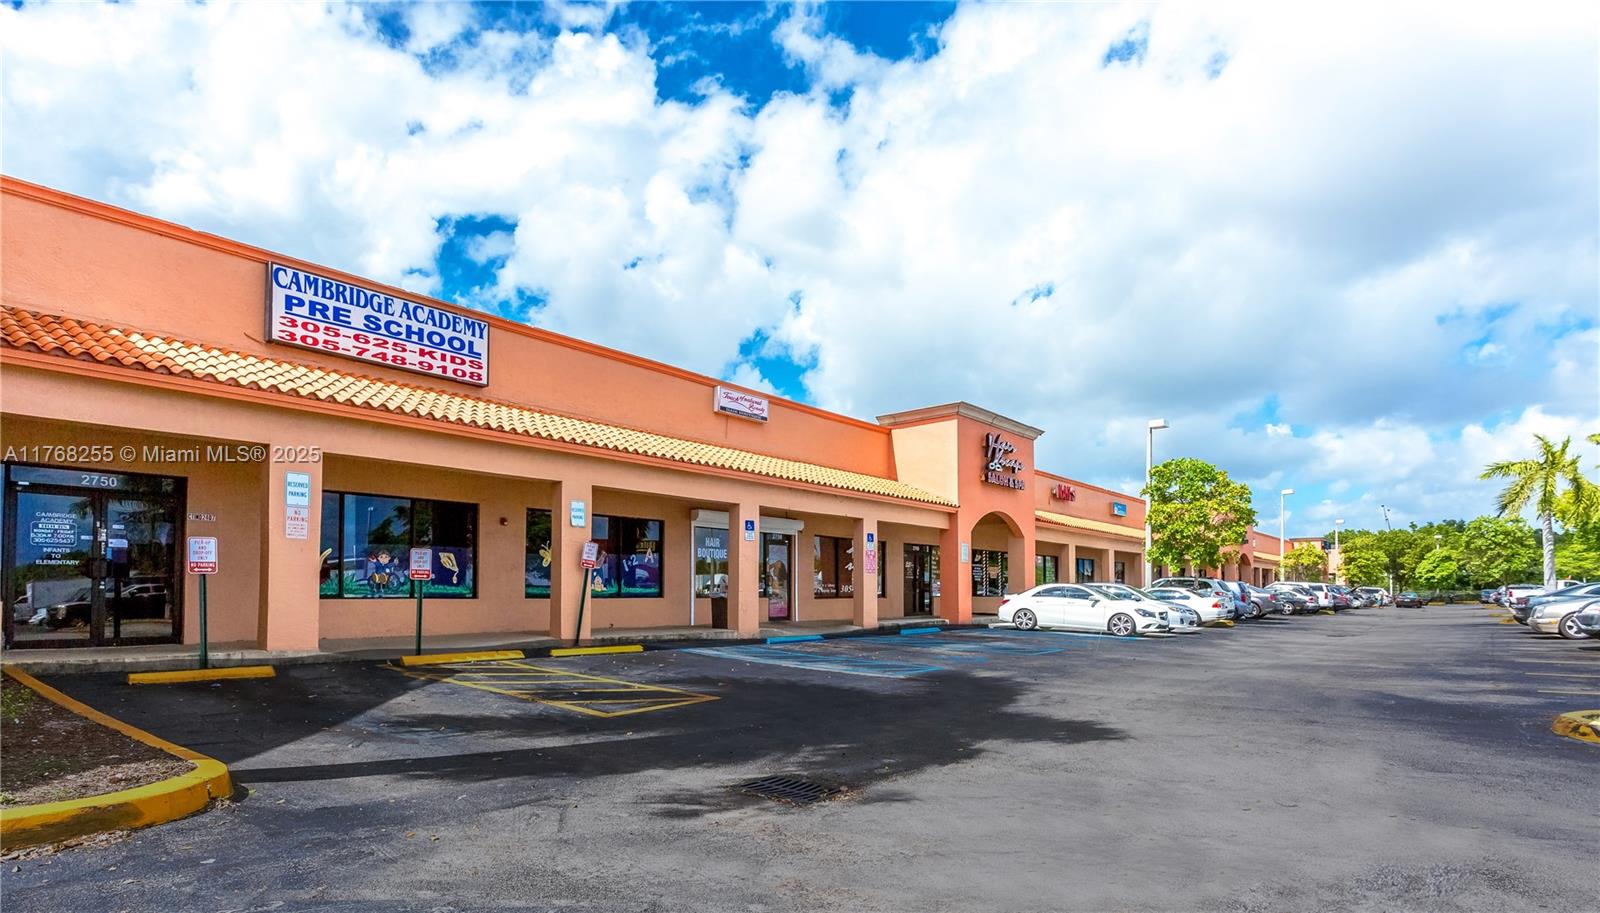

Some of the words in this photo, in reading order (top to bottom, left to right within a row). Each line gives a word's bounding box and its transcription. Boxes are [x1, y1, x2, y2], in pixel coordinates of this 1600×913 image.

[273, 267, 395, 318] CAMBRIDGE
[399, 302, 487, 340] ACADEMY
[285, 294, 350, 324] PRE
[363, 314, 481, 357] SCHOOL
[279, 315, 484, 370] 305-625-KIDS
[278, 329, 483, 381] 305-748-9108
[81, 475, 118, 488] 2750
[988, 471, 1008, 487] SALON
[1015, 478, 1025, 490] SPA
[35, 511, 78, 519] CAMBRIDGE
[705, 537, 720, 547] HAIR
[697, 548, 727, 558] BOUTIQUE
